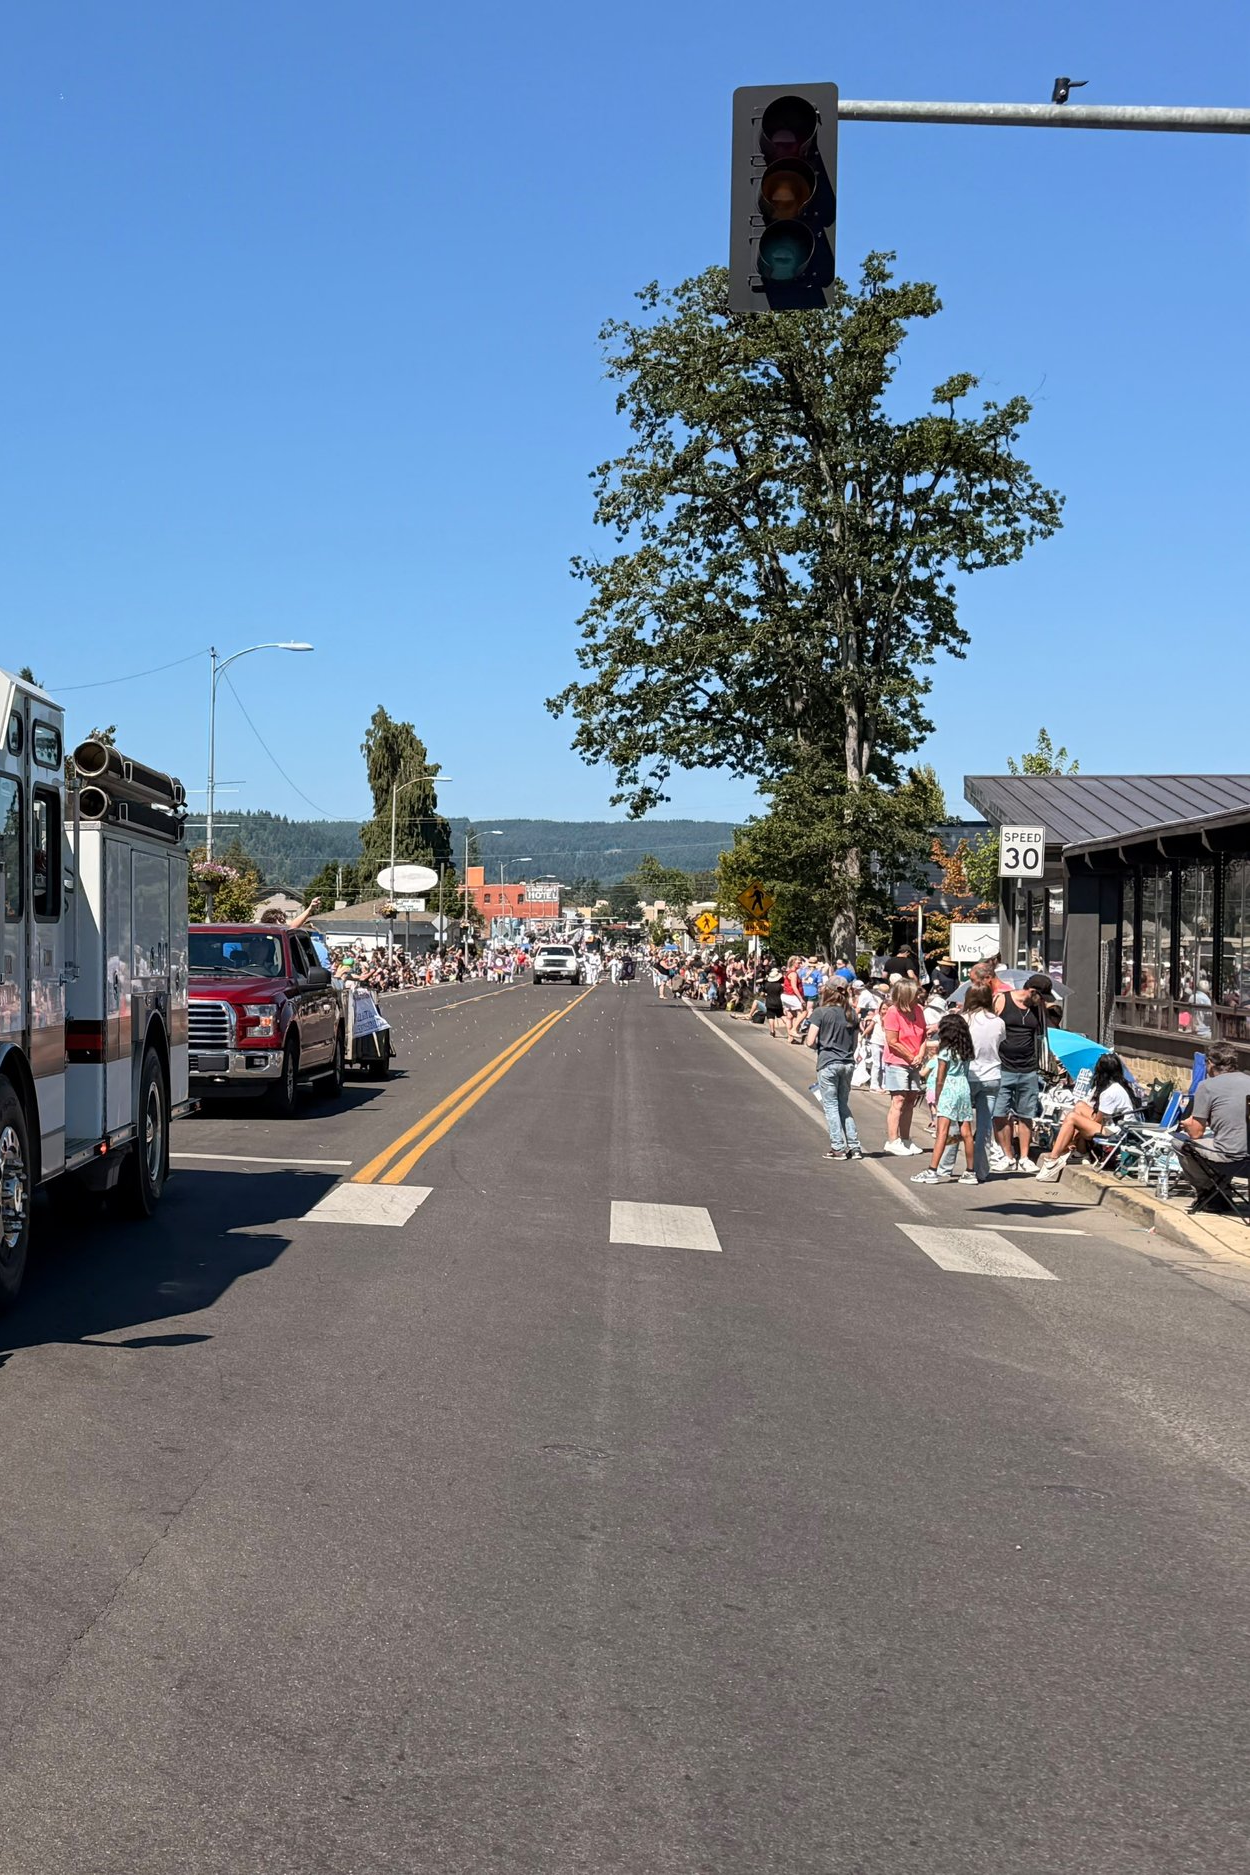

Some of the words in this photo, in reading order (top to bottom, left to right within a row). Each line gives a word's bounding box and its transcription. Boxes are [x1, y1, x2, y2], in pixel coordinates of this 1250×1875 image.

[1004, 832, 1041, 843] SPEED
[1004, 847, 1039, 870] 30
[528, 891, 557, 899] HOTEL
[957, 944, 981, 953] West
